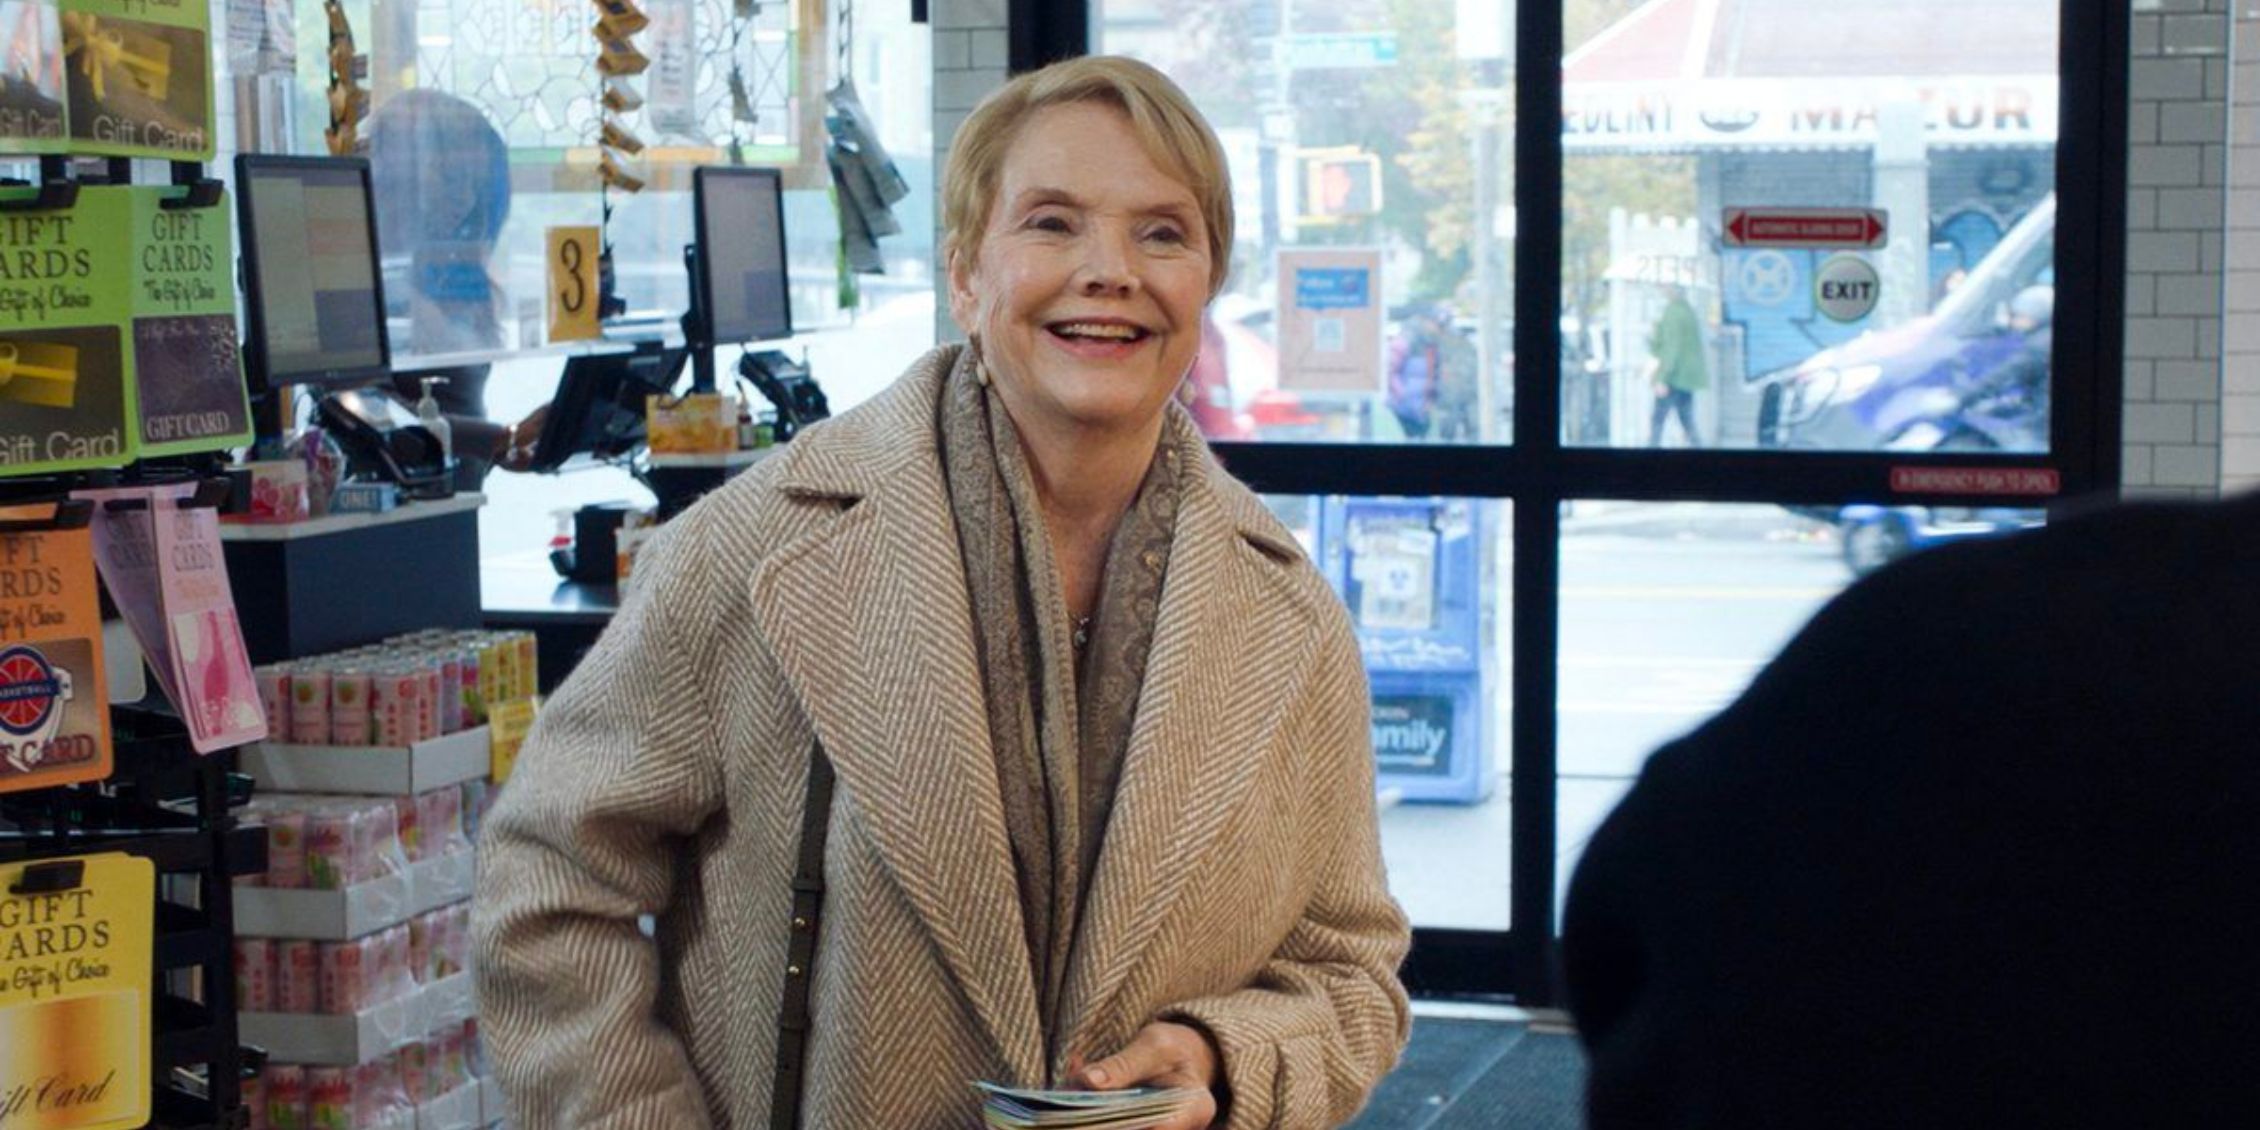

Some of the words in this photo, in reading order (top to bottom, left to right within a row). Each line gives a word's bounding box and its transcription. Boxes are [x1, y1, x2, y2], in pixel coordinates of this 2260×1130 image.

[92, 114, 136, 143] Gift
[143, 119, 208, 150] Card
[0, 213, 73, 248] IFT
[152, 212, 203, 242] GIFT
[142, 244, 214, 273] CARDS
[561, 238, 584, 313] 3
[1822, 281, 1873, 300] EXIT
[46, 427, 119, 461] Card
[0, 889, 94, 929] GIFT
[0, 919, 110, 961] ARDS
[13, 965, 46, 998] Gift
[66, 955, 110, 983] Choice
[36, 1067, 117, 1113] Card
